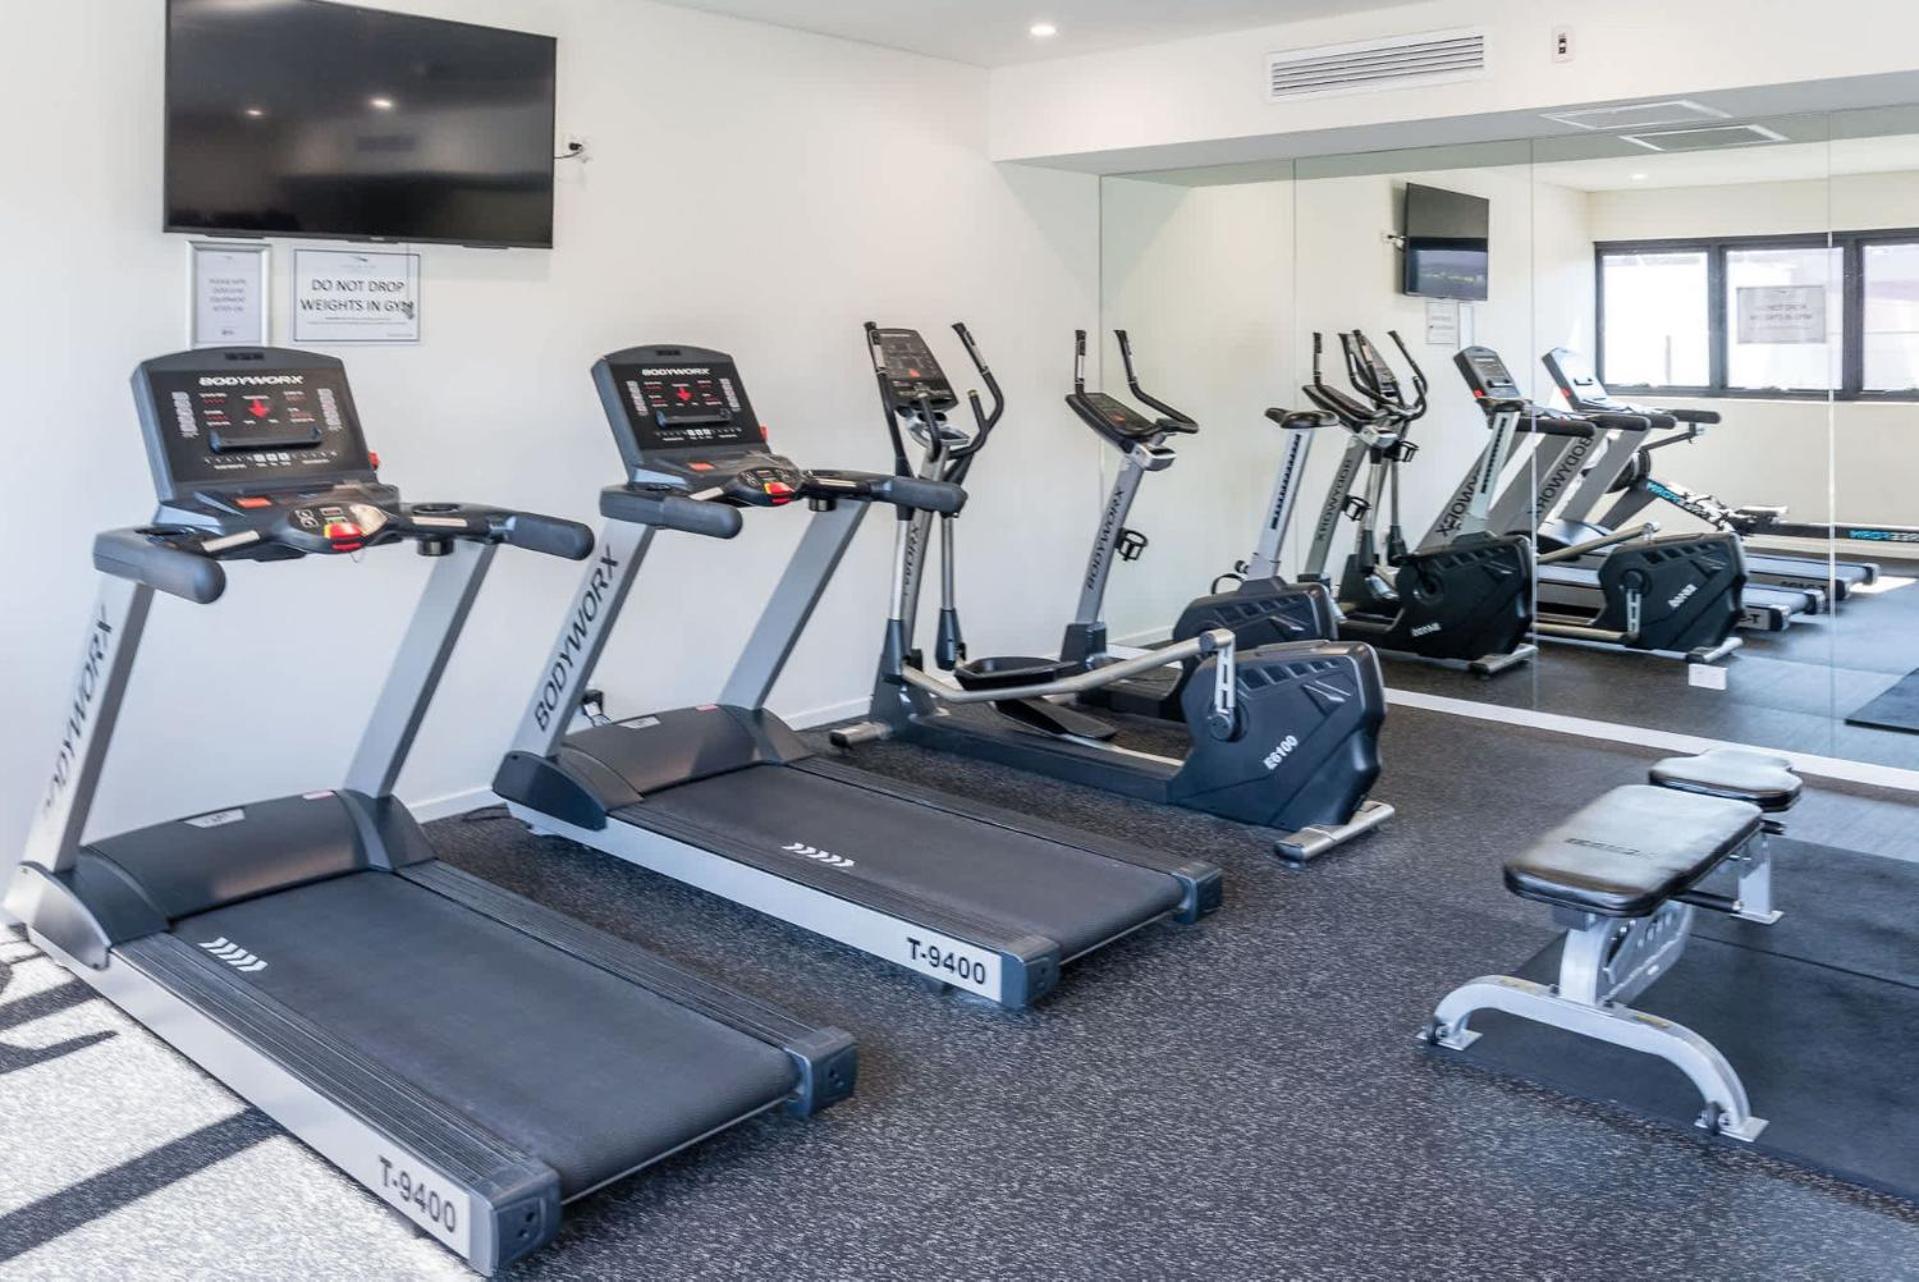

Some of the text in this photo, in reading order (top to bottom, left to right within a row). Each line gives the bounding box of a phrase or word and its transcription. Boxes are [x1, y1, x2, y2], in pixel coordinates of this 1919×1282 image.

[312, 279, 405, 293] DO NOT DROP
[300, 298, 363, 312] WEIGHTS
[367, 300, 381, 312] IN
[199, 375, 304, 387] BODYWORX
[641, 368, 710, 377] BODYWORX
[1087, 487, 1125, 591] BODYWORX
[534, 543, 619, 732] BODYWORX
[1263, 734, 1299, 770] E6100
[907, 936, 986, 985] T-9400
[378, 1155, 456, 1233] T-9400
